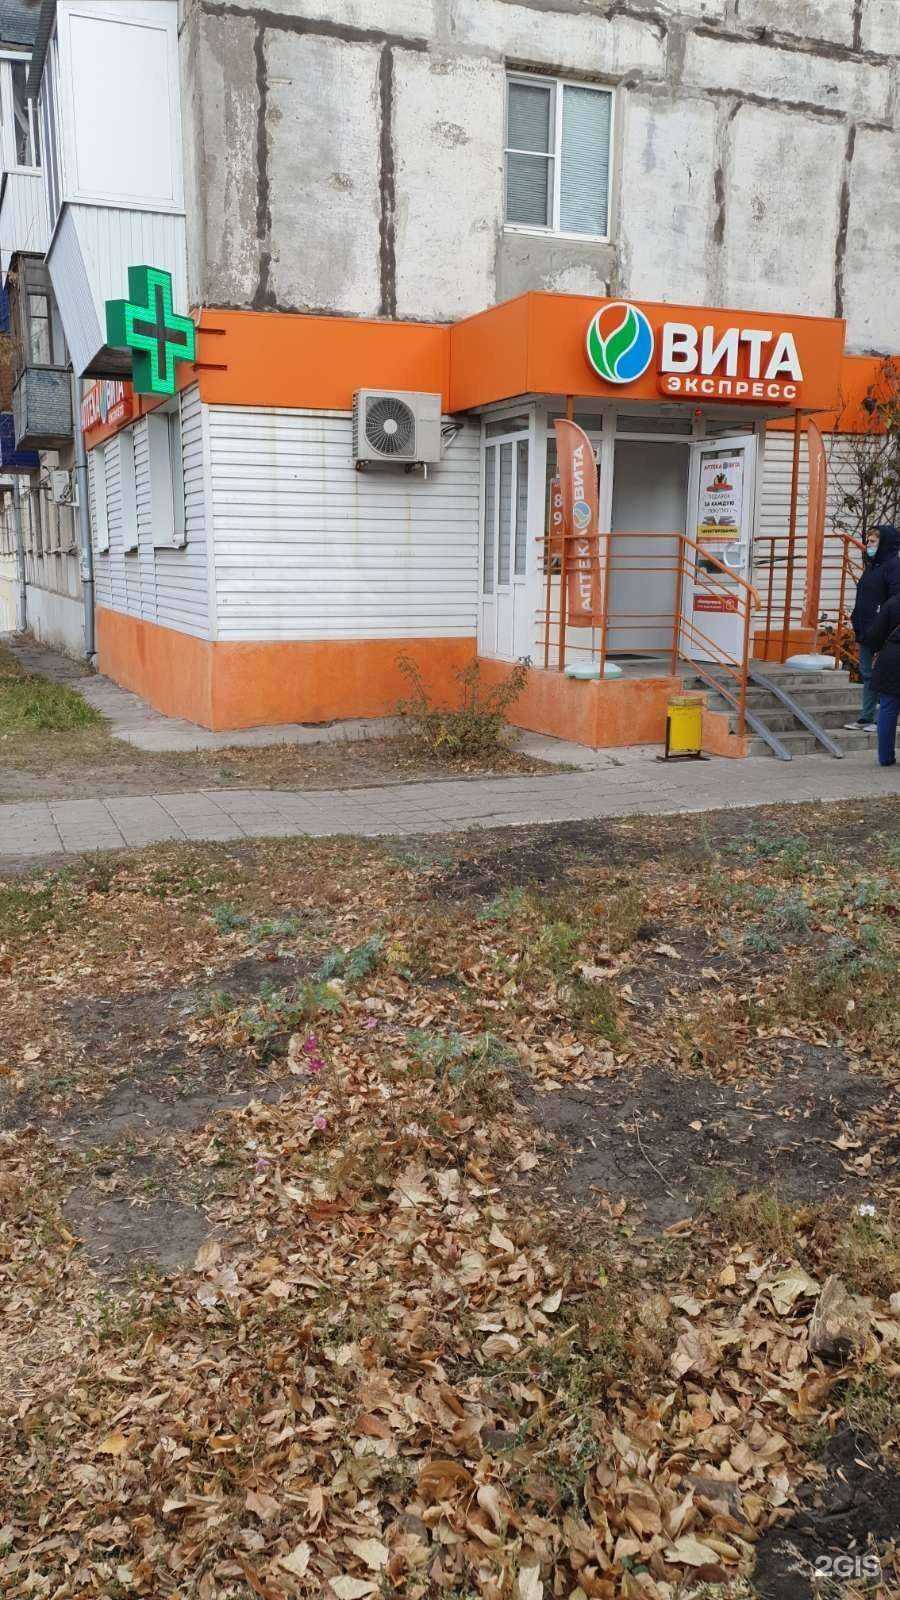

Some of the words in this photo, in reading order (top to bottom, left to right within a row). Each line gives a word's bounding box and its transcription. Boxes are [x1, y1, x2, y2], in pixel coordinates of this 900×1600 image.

[661, 321, 804, 382] ВИТА
[667, 376, 797, 399] ЭКСПРЕСС
[572, 443, 585, 501] ВИТА
